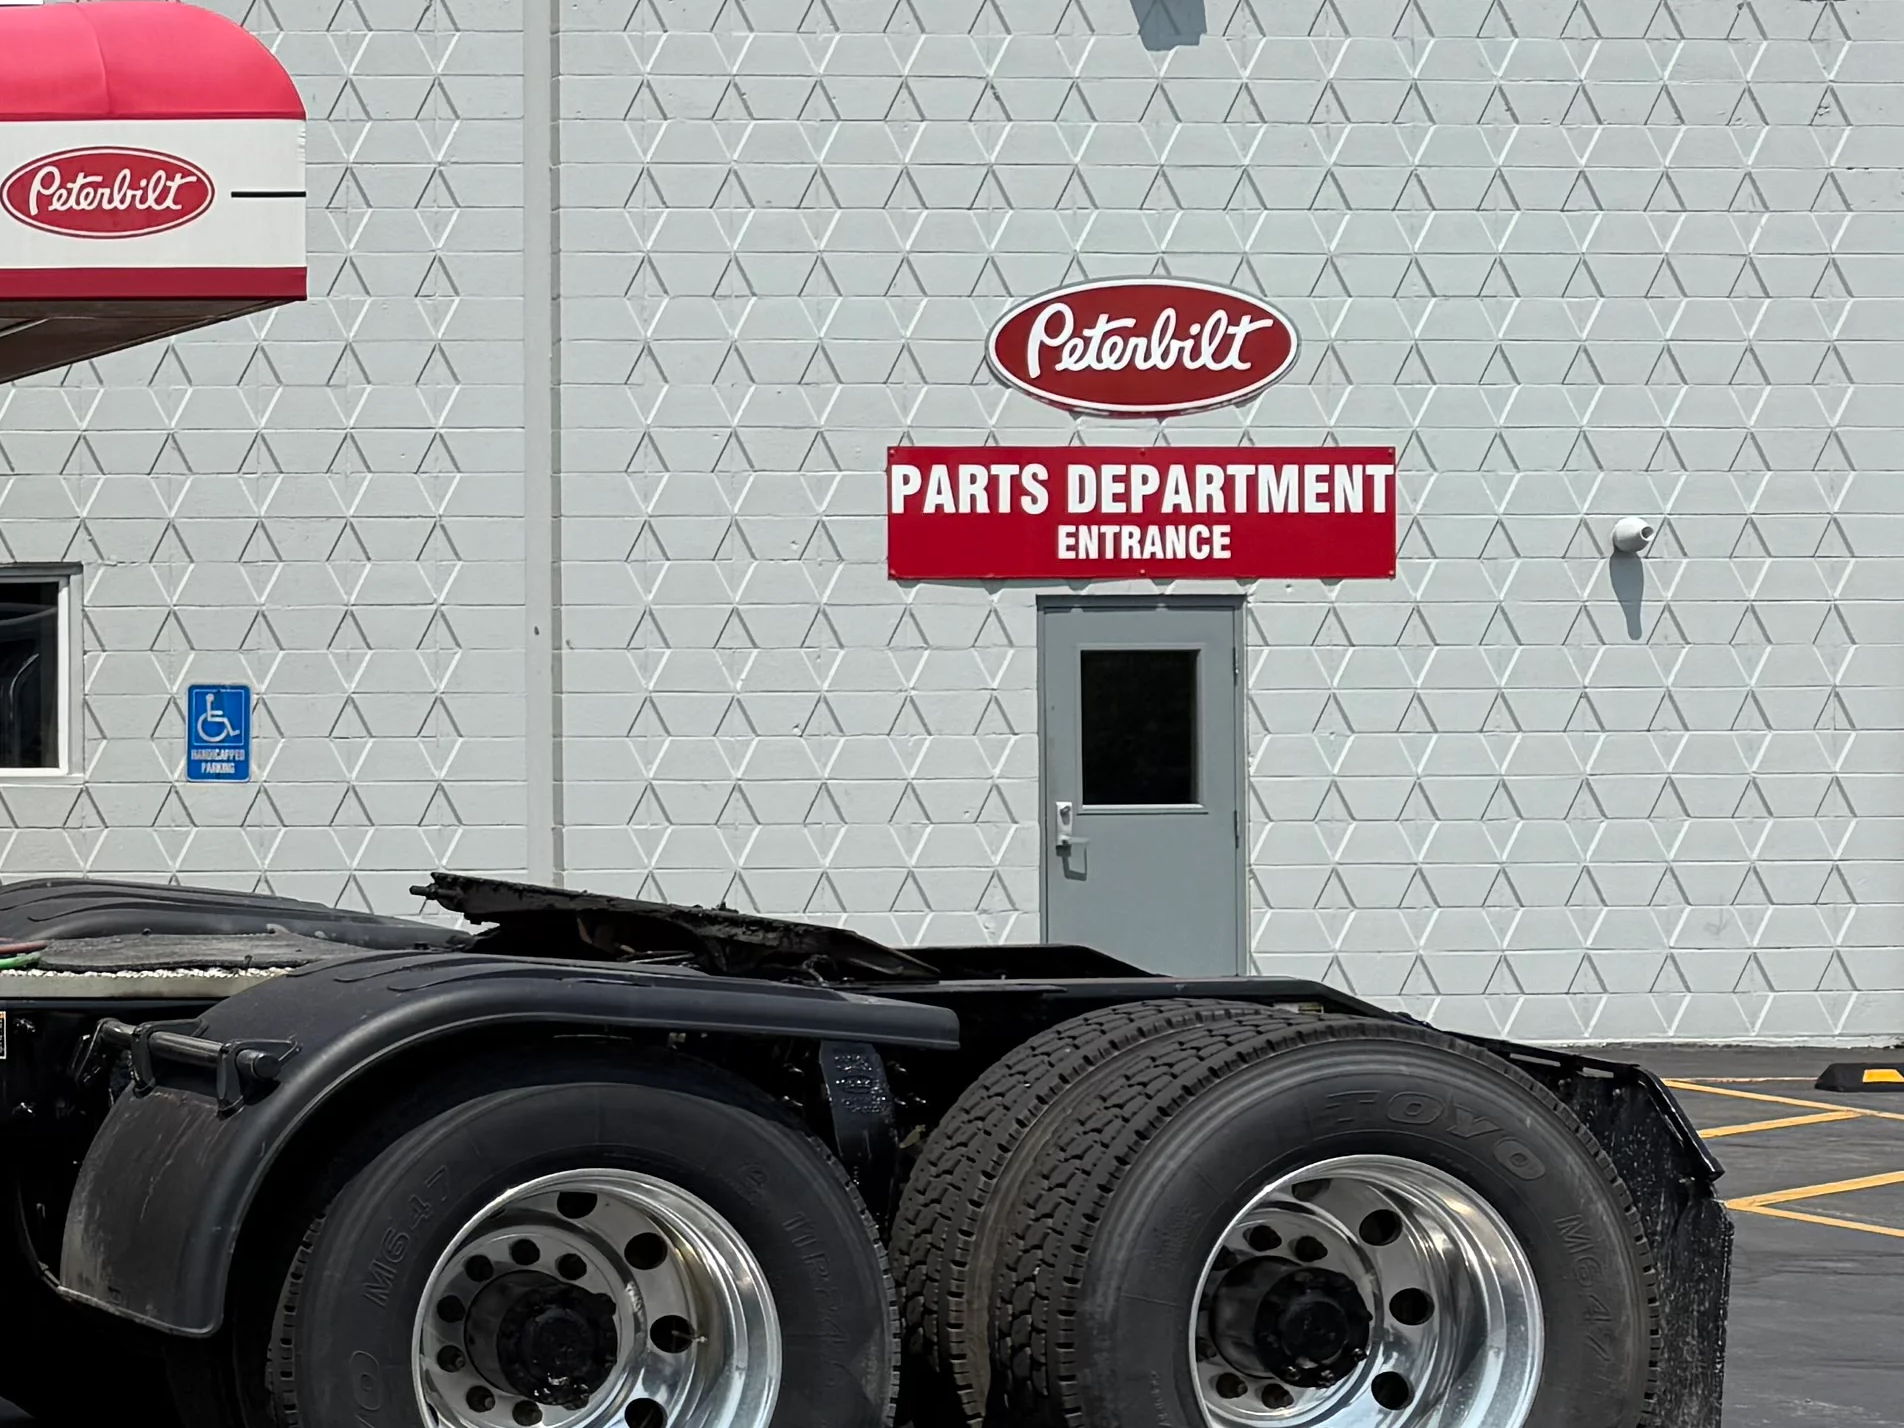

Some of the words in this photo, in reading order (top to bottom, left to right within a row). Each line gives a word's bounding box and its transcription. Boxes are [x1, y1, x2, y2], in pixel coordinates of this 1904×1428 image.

[27, 165, 196, 213] Peterbilt
[1026, 302, 1274, 379] Peterbilt
[891, 464, 1048, 515] PARTS
[1068, 463, 1395, 514] DEPARTMENT
[1057, 524, 1232, 560] ENTRANCE
[1324, 1088, 1547, 1182] TOYO
